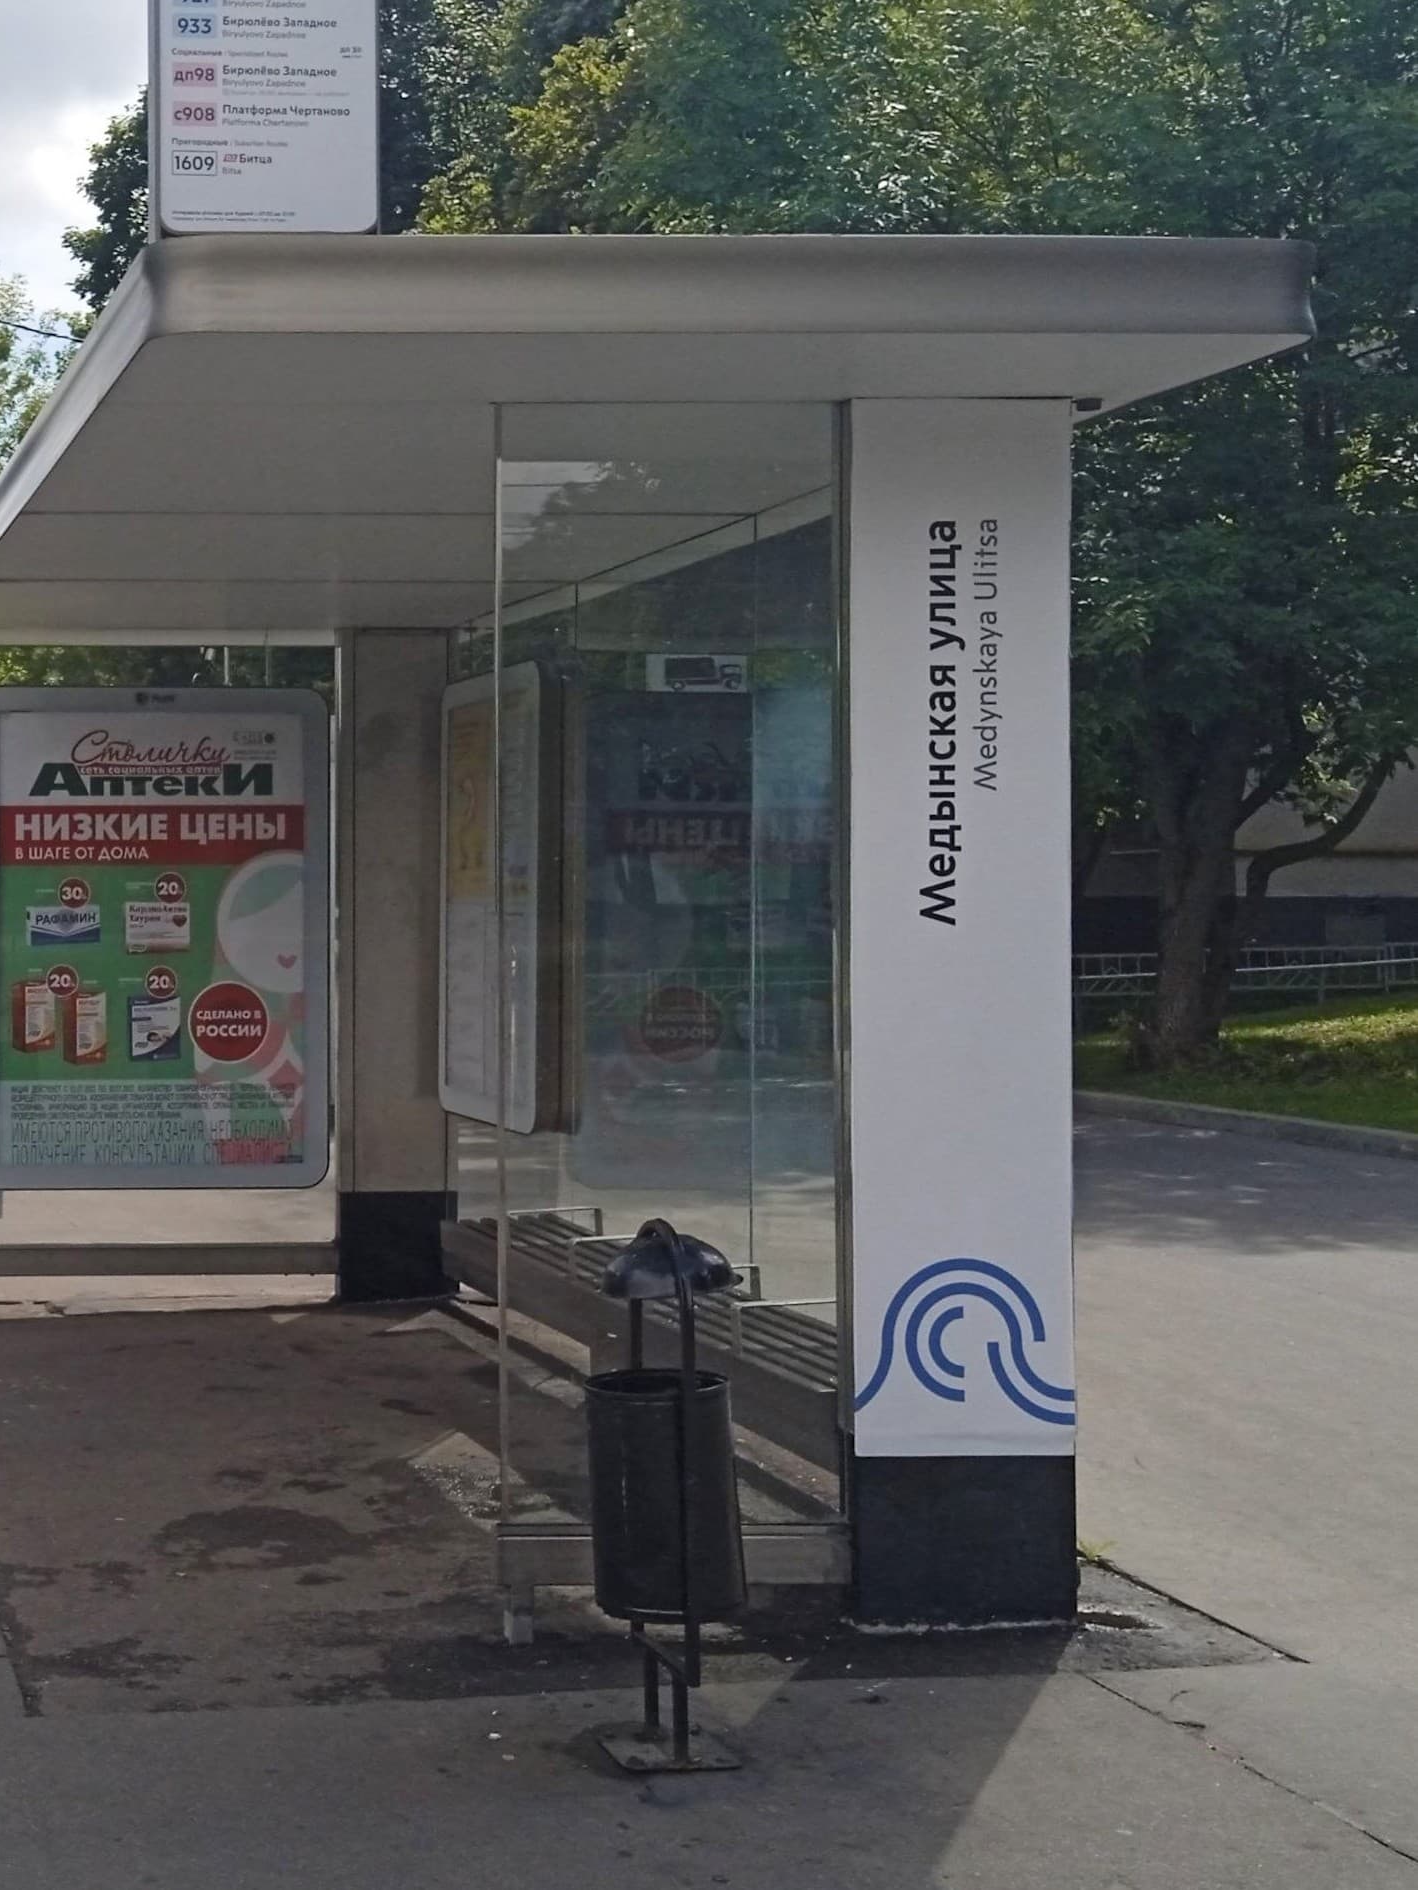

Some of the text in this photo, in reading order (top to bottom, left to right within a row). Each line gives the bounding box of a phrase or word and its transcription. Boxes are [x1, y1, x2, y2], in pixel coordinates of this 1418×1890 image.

[177, 16, 337, 34] 933 Бирюлёво Западное
[174, 65, 337, 82] дп98 Бирюлёво Западное
[174, 105, 351, 121] с908 Платформа Чертаново
[174, 155, 215, 171] 1609
[239, 153, 272, 164] Битца
[972, 518, 1003, 791] Medynskaya Ulitsa
[918, 520, 966, 926] Медынская улица
[15, 814, 286, 846] НИЗКИЕ ЦЕНЫ
[15, 847, 149, 861] В ШАГЕ ОТ ДОМА
[35, 912, 96, 925] РАФАМИН
[196, 1010, 253, 1021] СДЕЛАНО
[196, 1024, 263, 1038] РОССИИ
